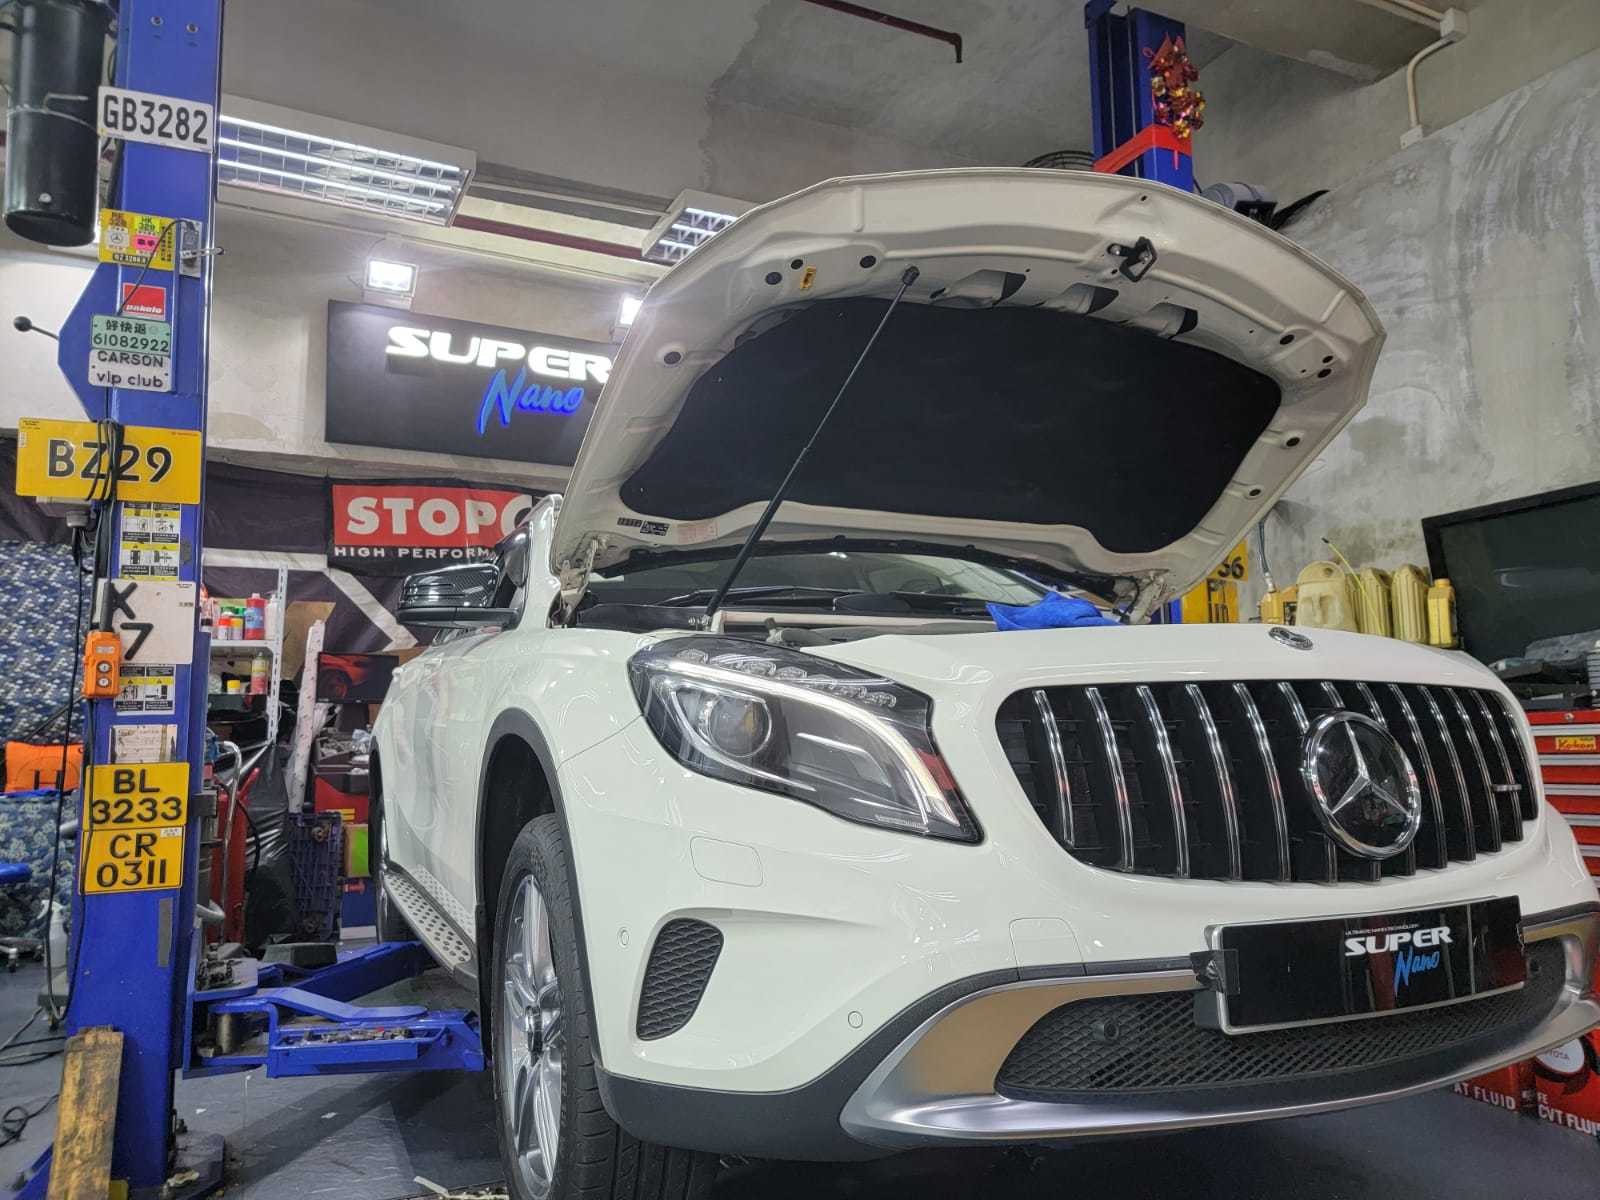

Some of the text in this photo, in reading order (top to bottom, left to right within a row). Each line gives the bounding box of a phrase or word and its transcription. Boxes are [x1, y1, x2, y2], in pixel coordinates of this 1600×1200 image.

[103, 94, 208, 145] GB3282
[93, 332, 169, 353] 61082922
[385, 326, 613, 384] SUPER
[97, 350, 164, 368] CARSON
[127, 374, 164, 388] club
[475, 367, 585, 437] Nano
[334, 546, 496, 560] HIGH PERFORM
[113, 769, 160, 795] BL
[92, 797, 182, 825] 3233
[110, 833, 158, 859] CR
[97, 860, 167, 888] 0311
[1344, 926, 1453, 957] SUPER
[1393, 945, 1440, 999] Nano
[1454, 1081, 1469, 1097] AT
[1474, 1085, 1516, 1110] FLUID
[1538, 1104, 1600, 1137] CVT FLUI
